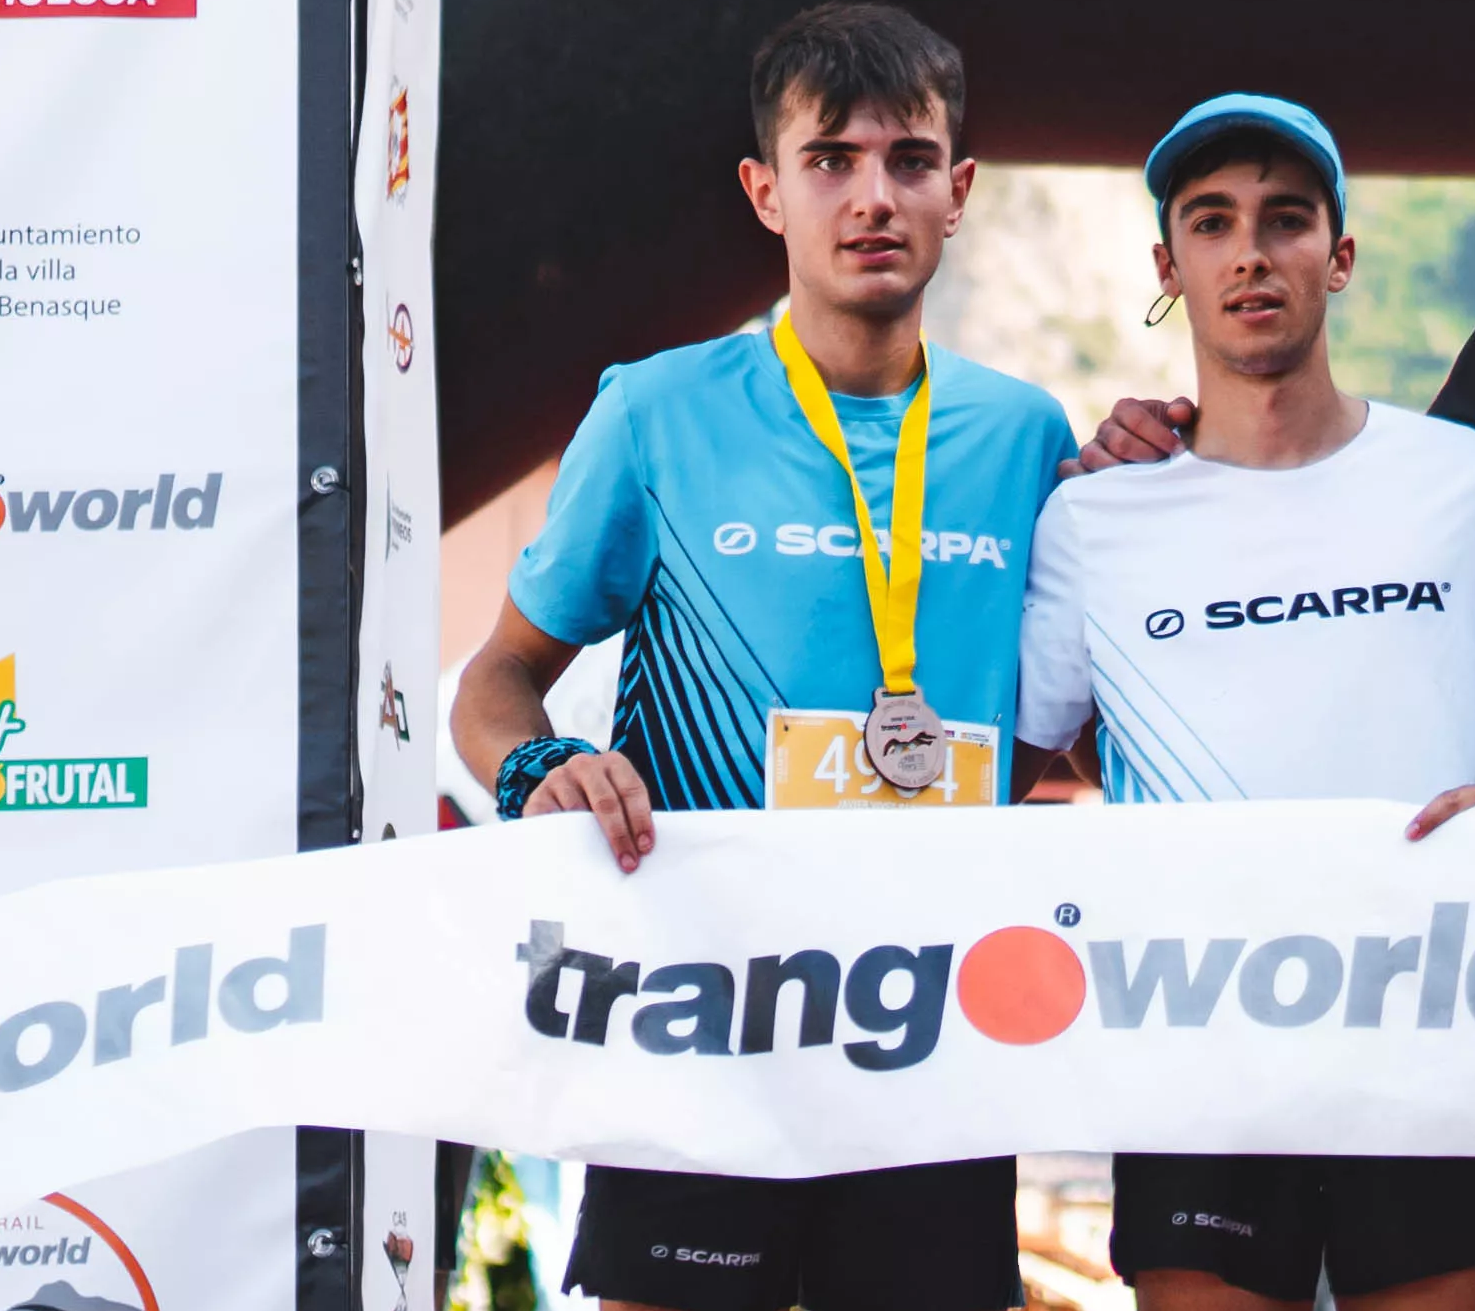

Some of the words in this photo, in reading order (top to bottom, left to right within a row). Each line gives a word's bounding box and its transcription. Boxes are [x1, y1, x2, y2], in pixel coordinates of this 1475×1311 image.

[26, 259, 77, 282] villa
[1205, 581, 1445, 630] SCARPA
[813, 735, 960, 803] 494
